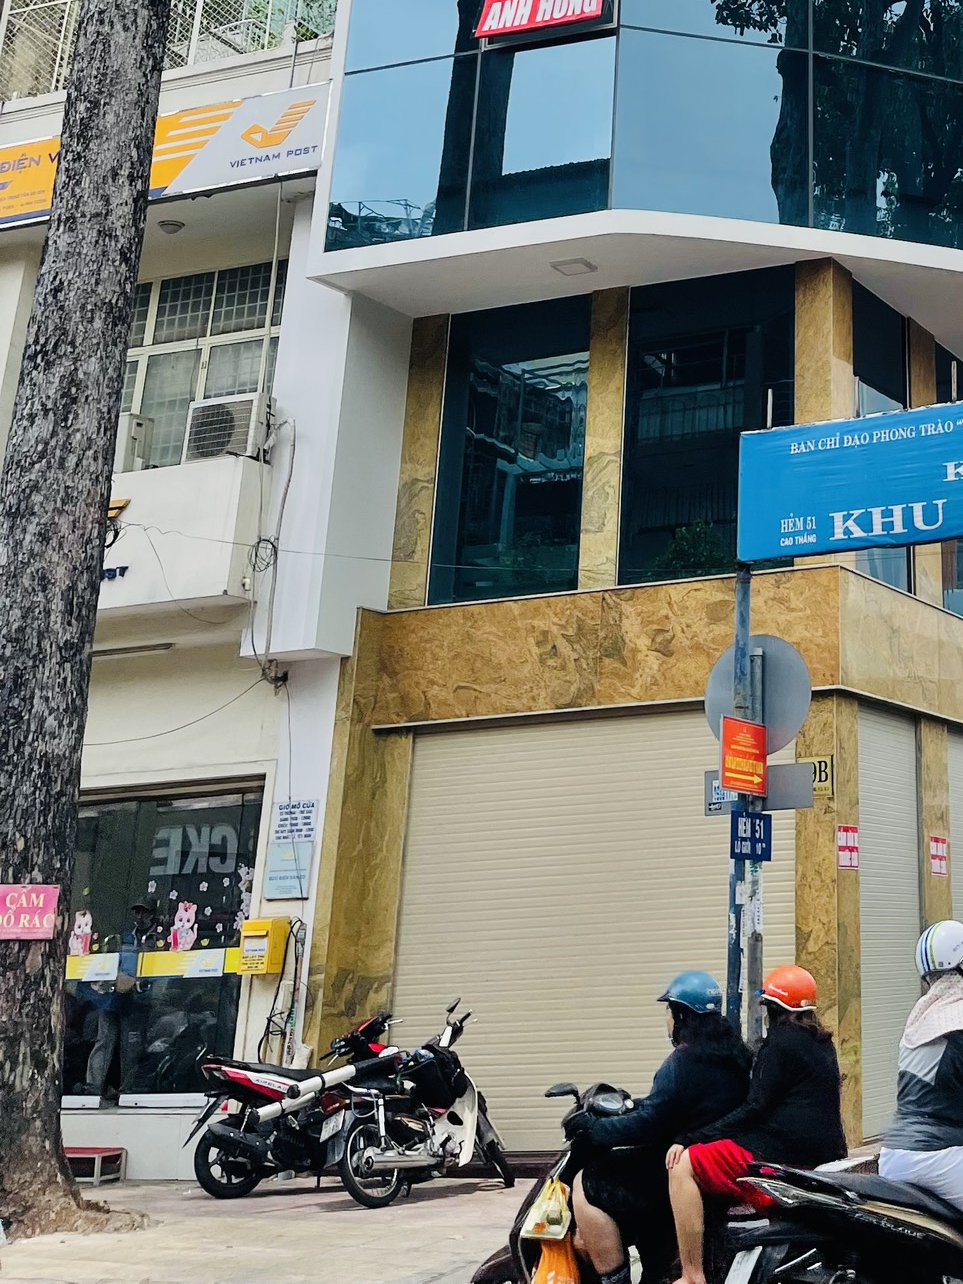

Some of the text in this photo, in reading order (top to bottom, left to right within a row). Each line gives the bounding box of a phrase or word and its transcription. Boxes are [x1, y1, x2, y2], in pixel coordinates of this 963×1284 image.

[230, 145, 318, 168] VIETNAM POST
[790, 440, 816, 454] BAN
[818, 433, 841, 450] CHỈ
[843, 433, 870, 452] ĐẠO
[872, 426, 917, 444] PHONG
[919, 418, 954, 437] TRÀO
[806, 516, 816, 530] 51
[829, 499, 948, 541] KHU
[780, 536, 793, 546] CAO
[755, 819, 764, 839] 51
[5, 886, 45, 908] CẤM
[0, 907, 15, 928] Ổ
